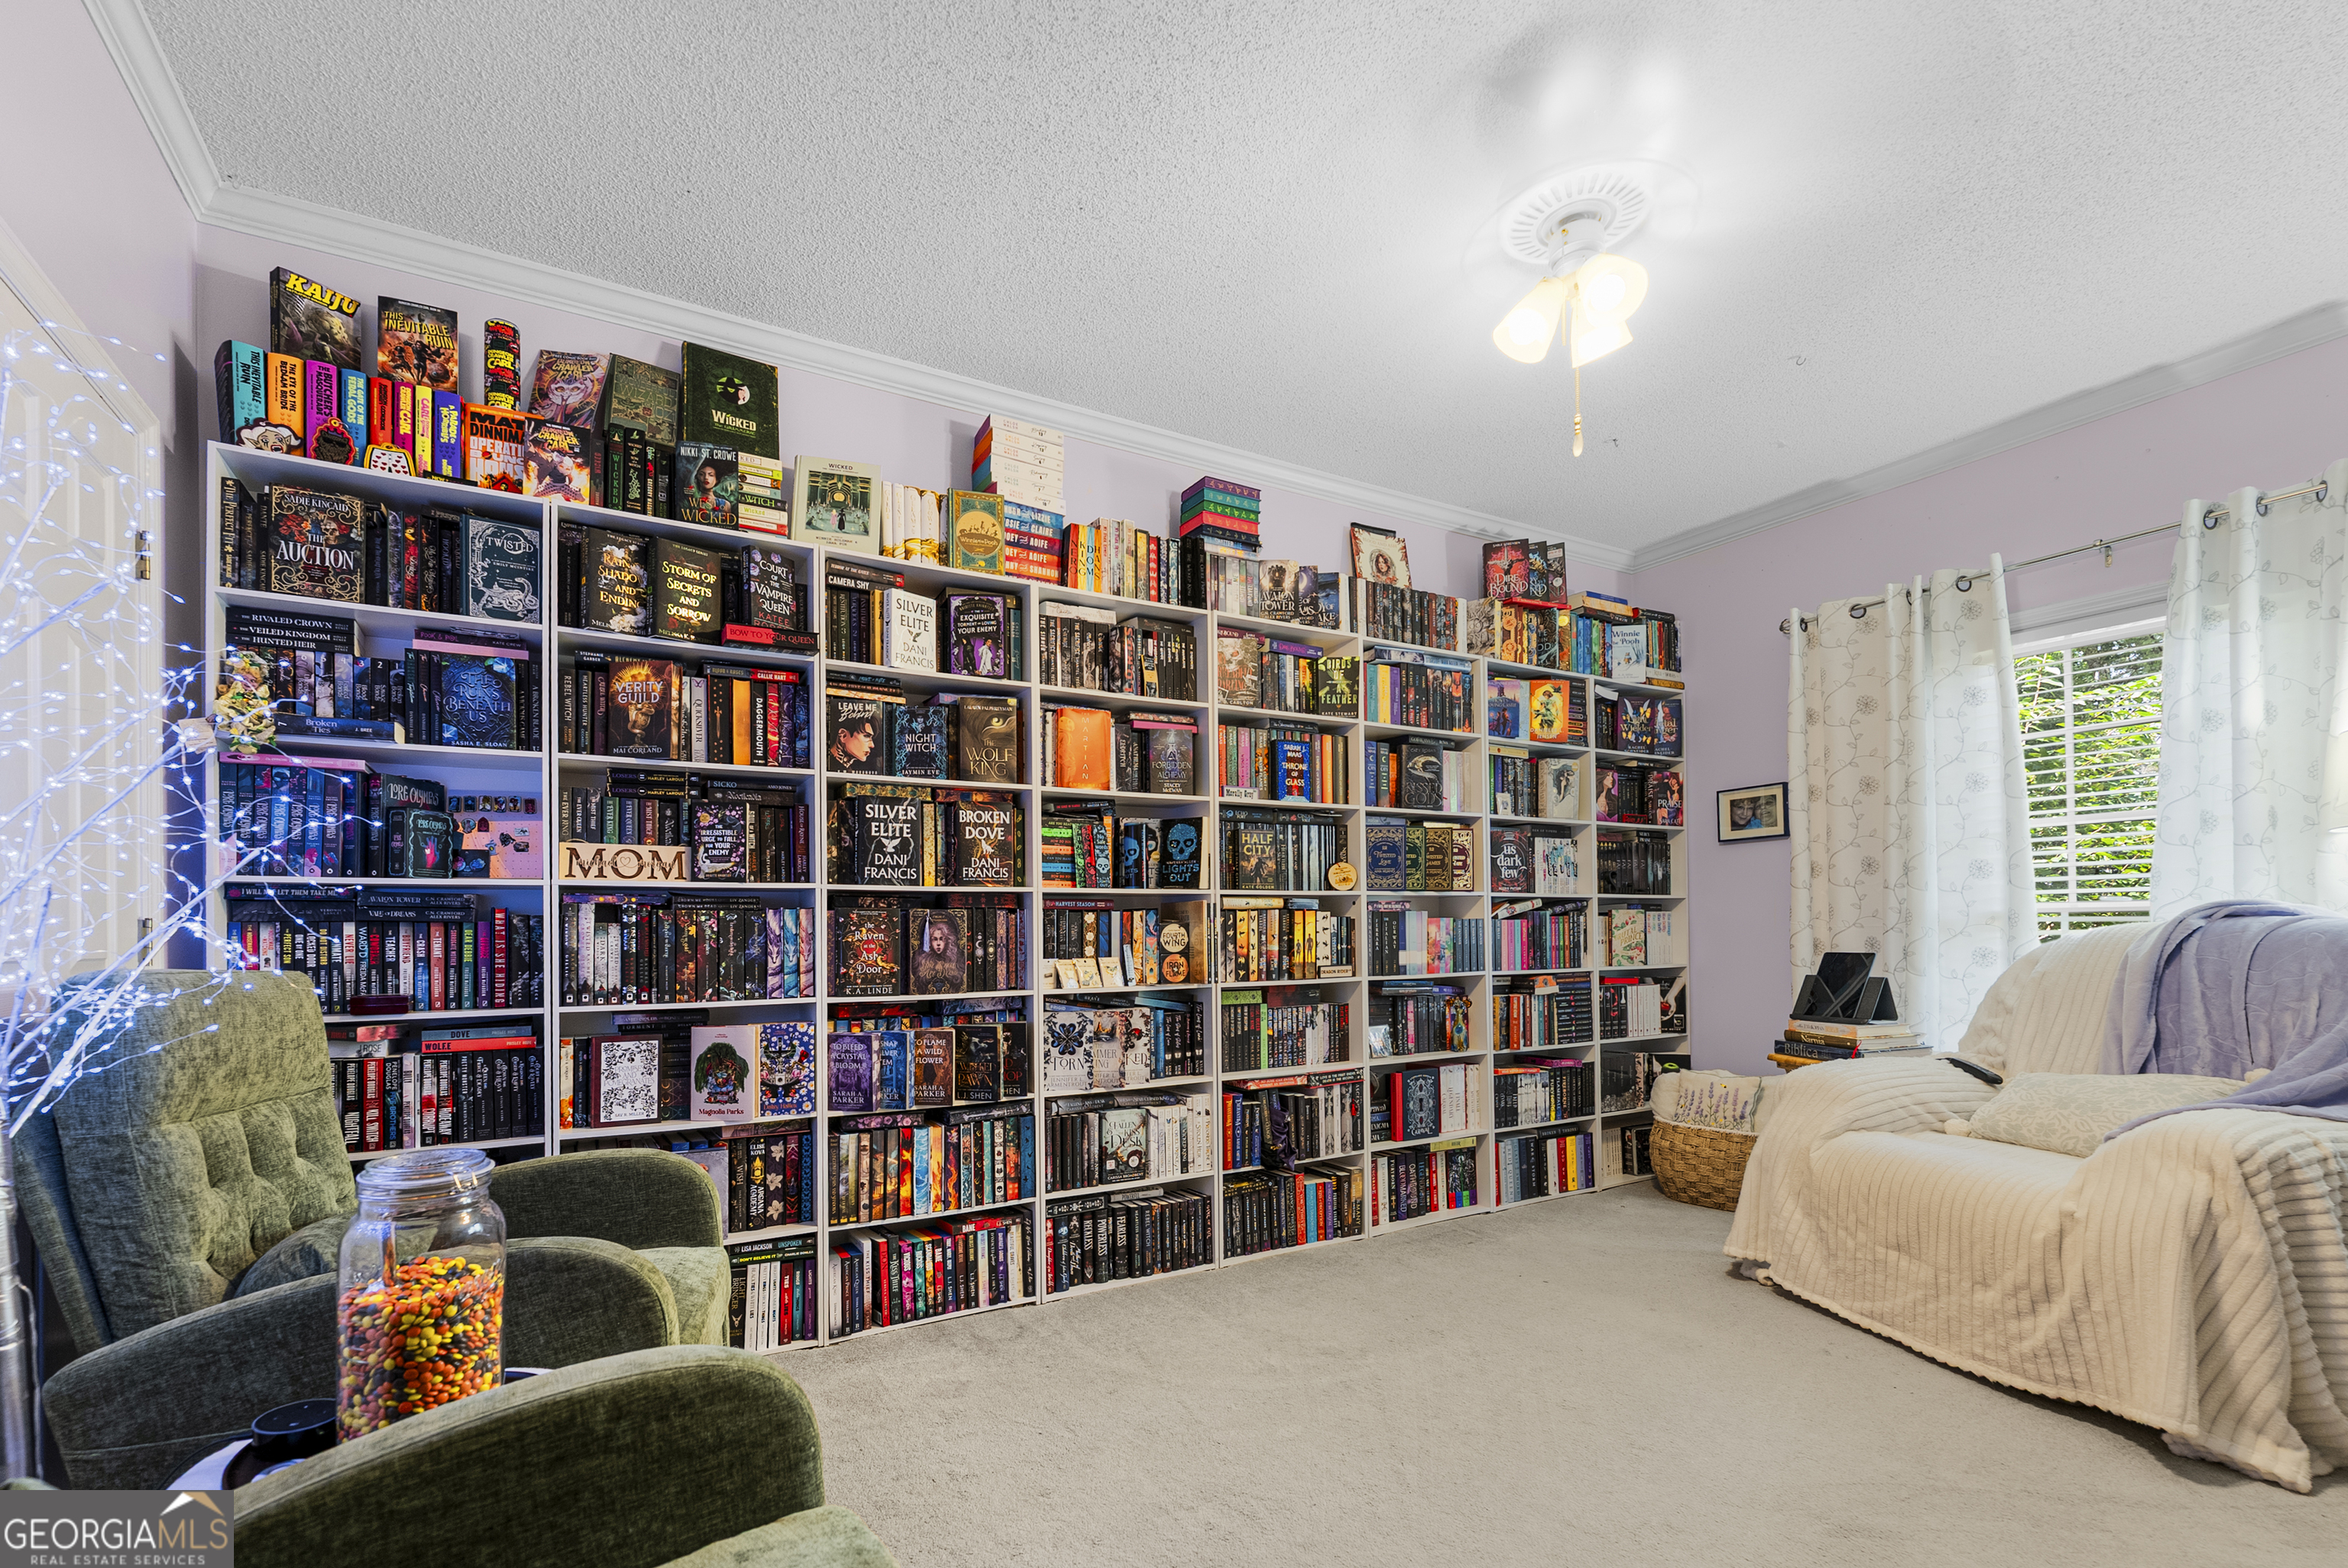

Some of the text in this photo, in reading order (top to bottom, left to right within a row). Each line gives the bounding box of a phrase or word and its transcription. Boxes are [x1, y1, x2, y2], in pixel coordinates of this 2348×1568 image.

[286, 274, 360, 315] KAIJU
[384, 311, 404, 320] THIS
[384, 319, 450, 337] INEVITABLE
[425, 335, 454, 350] RUIN
[290, 389, 296, 397] OF
[323, 372, 333, 417] BUTCHER'S
[712, 409, 757, 432] WICKED
[680, 446, 699, 457] NIKKI
[701, 448, 712, 458] ST.
[713, 448, 737, 462] CROWE
[284, 494, 349, 513] SADIE KINCAID
[1032, 511, 1051, 523] LIZZIE
[1031, 524, 1053, 537] CLAIRE
[308, 533, 324, 543] THE
[486, 536, 534, 553] TWISTED
[1030, 537, 1049, 549] AOIFE
[276, 540, 354, 570] AUCTION
[1069, 539, 1078, 575] NERO
[662, 561, 717, 585] STORM OF
[760, 560, 789, 578] COURT
[770, 581, 780, 589] THE
[828, 575, 870, 590] CAMERA SHY
[1493, 573, 1520, 586] DIRE
[666, 578, 712, 598] SECRETS
[755, 582, 793, 604] VAMPIRE
[1487, 581, 1529, 598] BOUND
[679, 595, 699, 607] AND
[759, 598, 790, 616] QUEEN
[666, 603, 712, 623] SORROW
[252, 614, 332, 629] RIVALED CROWN
[249, 627, 330, 640] VEILED KINGDOM
[730, 628, 815, 645] BOW TO YOUR QUEEN
[1613, 630, 1640, 638] Winnie
[253, 637, 316, 649] HUNTED HEIR
[1326, 659, 1352, 669] BIRDS
[1333, 670, 1344, 680] OF
[453, 683, 500, 700] RUINS
[615, 681, 663, 692] VERITY
[443, 695, 511, 714] BENEATH
[618, 692, 660, 704] GUILD
[1321, 694, 1357, 705] FEATHER
[864, 703, 877, 711] ME
[469, 711, 487, 723] US
[838, 709, 875, 722] Behind
[755, 698, 764, 756] DAGGERMOUTH
[905, 734, 936, 744] NIGHT
[984, 737, 997, 747] THE
[628, 746, 663, 754] CORLAND
[904, 744, 936, 753] WITCH
[965, 747, 1013, 762] WOLF
[970, 761, 1007, 779] KING
[388, 782, 439, 808] LORE OLYMPUS
[1226, 789, 1254, 799] Morally Gray
[865, 804, 917, 820] SILVER
[959, 811, 1010, 824] BROKEN
[871, 822, 912, 837] ELITE
[965, 826, 1005, 840] DOVE
[1241, 834, 1273, 844] HALF
[1244, 844, 1272, 855] CITY
[1503, 845, 1517, 855] us
[565, 847, 687, 880] MOM
[874, 854, 907, 866] DANI
[971, 857, 1000, 868] DANI
[1497, 855, 1523, 867] dark
[864, 867, 917, 879] FRANCIS
[962, 867, 1009, 878] FRANCIS
[1162, 863, 1200, 873] LIGHTS
[1500, 866, 1519, 880] few
[1169, 873, 1192, 883] OUT
[855, 931, 884, 941] Raven
[1164, 938, 1186, 947] WING
[345, 934, 355, 964] NEVER LIE
[385, 936, 396, 962] TEACHER
[416, 939, 426, 957] CRASH
[433, 938, 442, 958] TENANT
[464, 929, 473, 962] DEAR DEBBIE
[495, 912, 505, 1004] WHAT IS SHE HIDING
[861, 952, 879, 961] Ash
[856, 964, 882, 974] Door
[1801, 1035, 1825, 1045] Narnia
[1784, 1043, 1818, 1058] Biblica
[1399, 1165, 1407, 1213] BLOODMARKED
[1409, 1164, 1418, 1209] OATHBOUND
[962, 1223, 976, 1233] BANE
[1117, 1216, 1126, 1246] FEARLESS
[1084, 1220, 1093, 1250] RECKLESS
[1098, 1219, 1107, 1255] POWERLESS
[753, 1242, 773, 1251] JACKSON
[777, 1240, 803, 1249] UNSPOKEN
